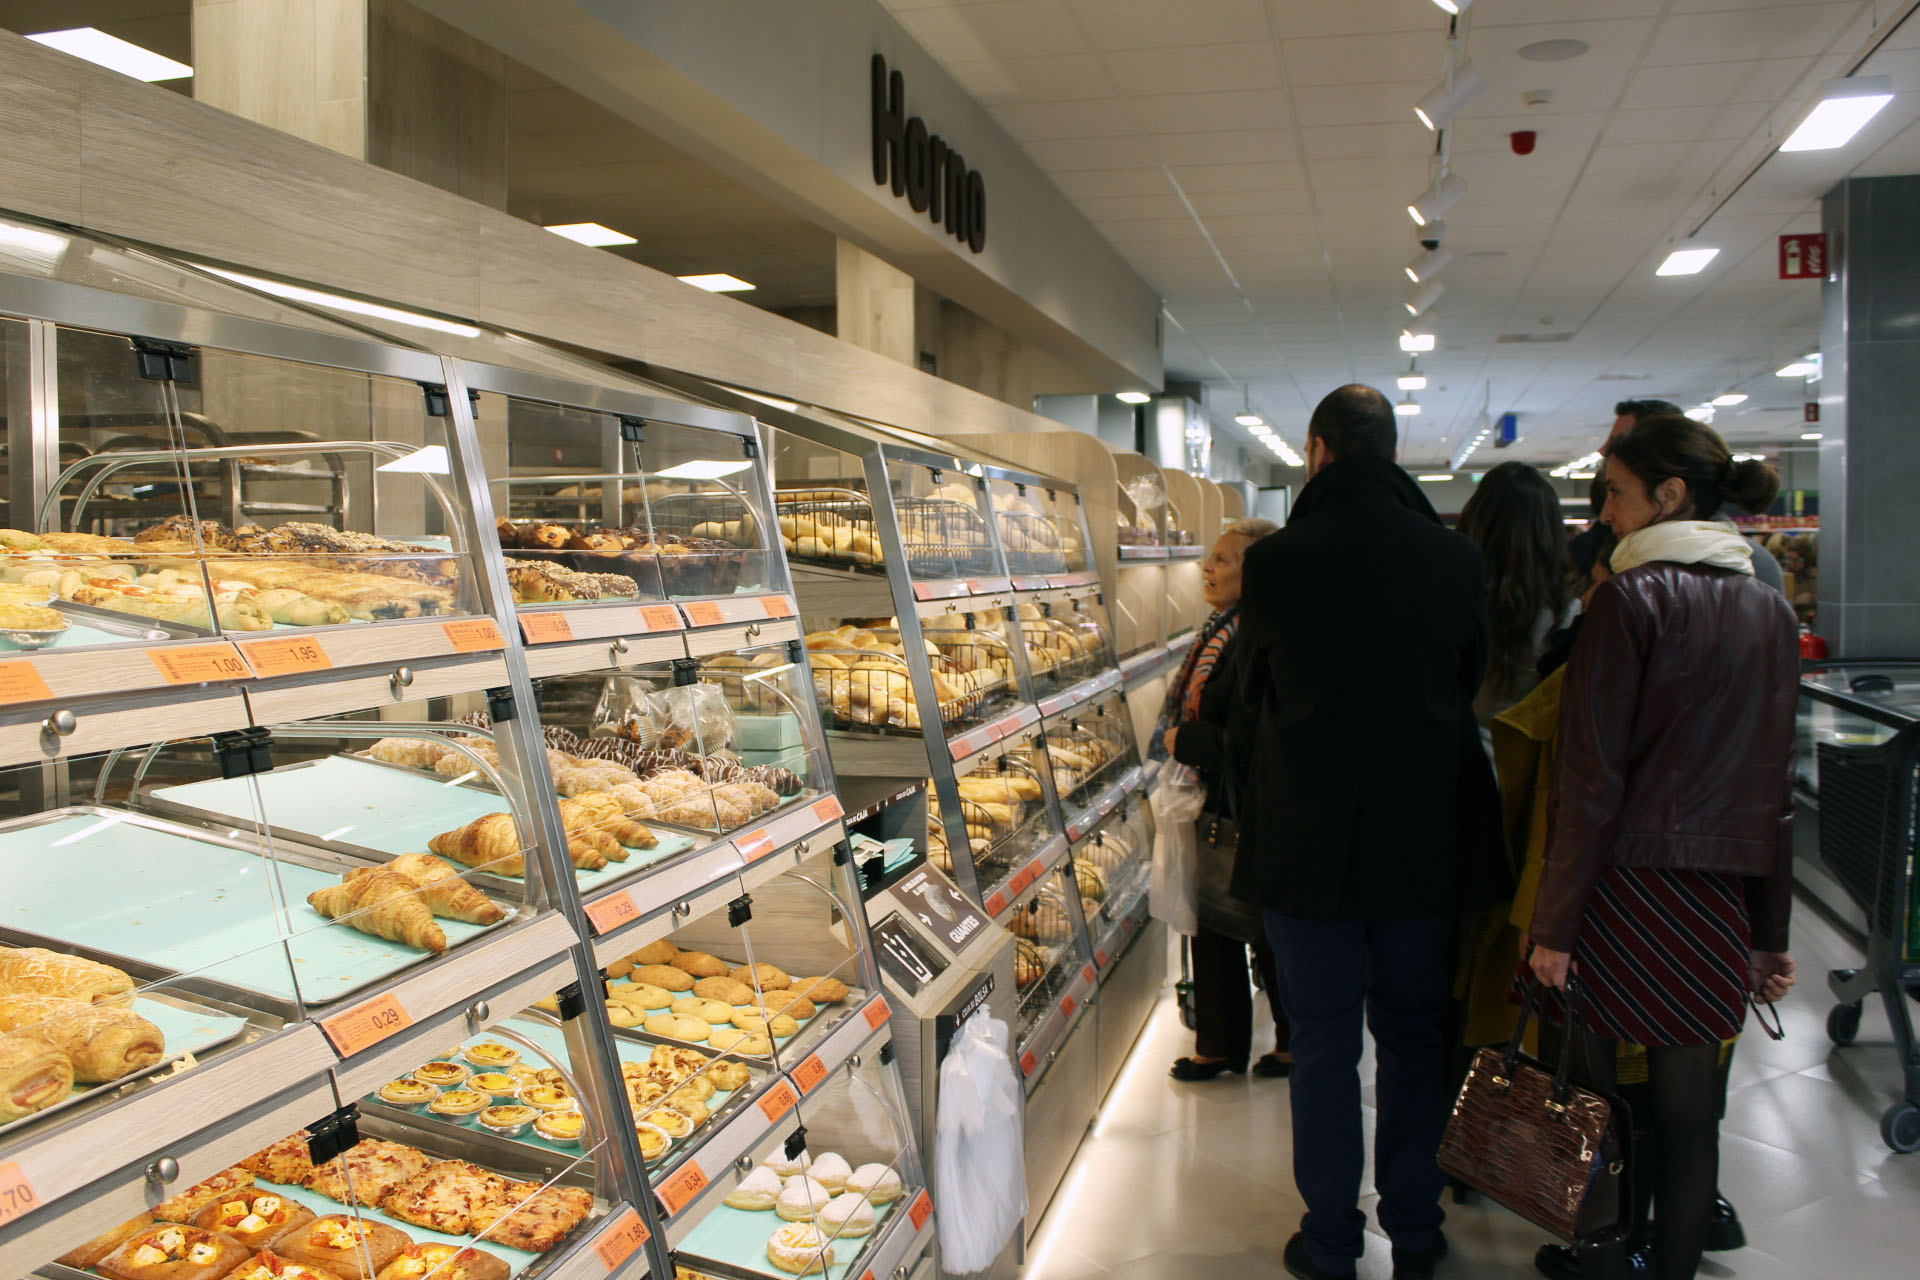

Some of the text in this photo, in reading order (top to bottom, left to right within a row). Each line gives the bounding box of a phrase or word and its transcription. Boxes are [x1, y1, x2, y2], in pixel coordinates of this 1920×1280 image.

[871, 53, 986, 254] Horno
[475, 626, 496, 641] 1,00
[288, 646, 318, 662] 1,95
[212, 657, 243, 675] 1,00
[614, 900, 633, 917] 0,29
[948, 914, 980, 944] GUANTES
[974, 983, 989, 1007] BOLSA
[371, 1008, 400, 1029] 0,29
[684, 1172, 702, 1192] 0,34
[0, 1183, 33, 1217] ,70
[627, 1223, 646, 1243] 1,80
